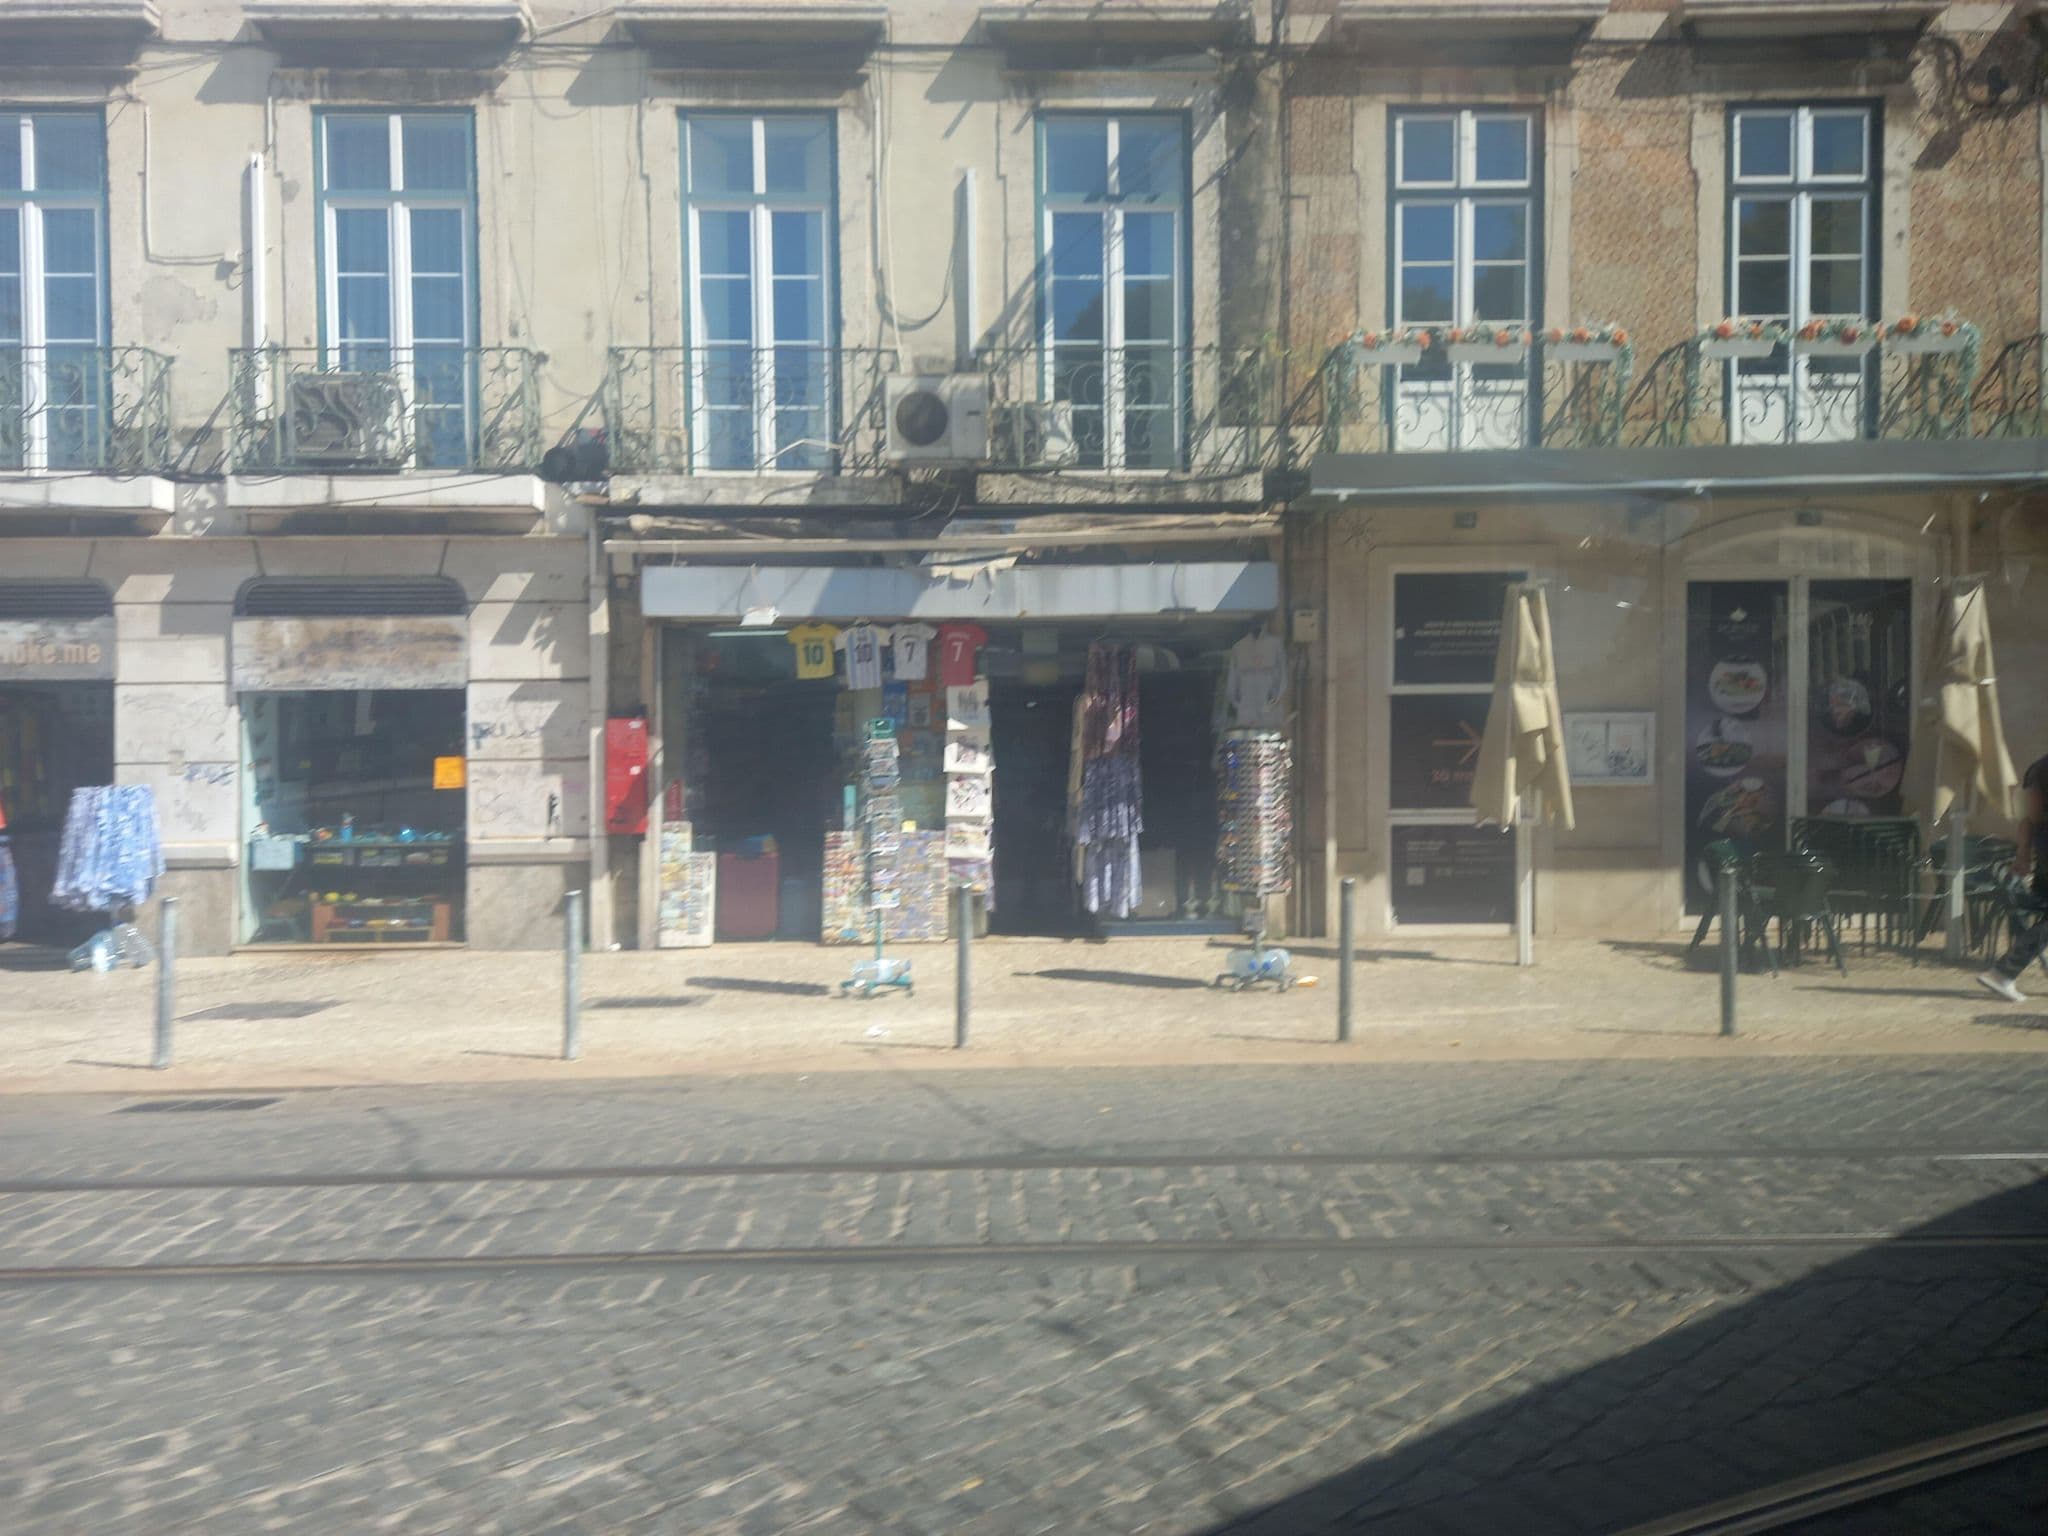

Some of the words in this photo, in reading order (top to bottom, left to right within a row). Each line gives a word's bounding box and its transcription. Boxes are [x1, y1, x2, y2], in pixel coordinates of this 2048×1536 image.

[804, 642, 824, 665] 10
[856, 642, 873, 664] 10
[904, 641, 915, 662] 7
[951, 641, 964, 662] 7
